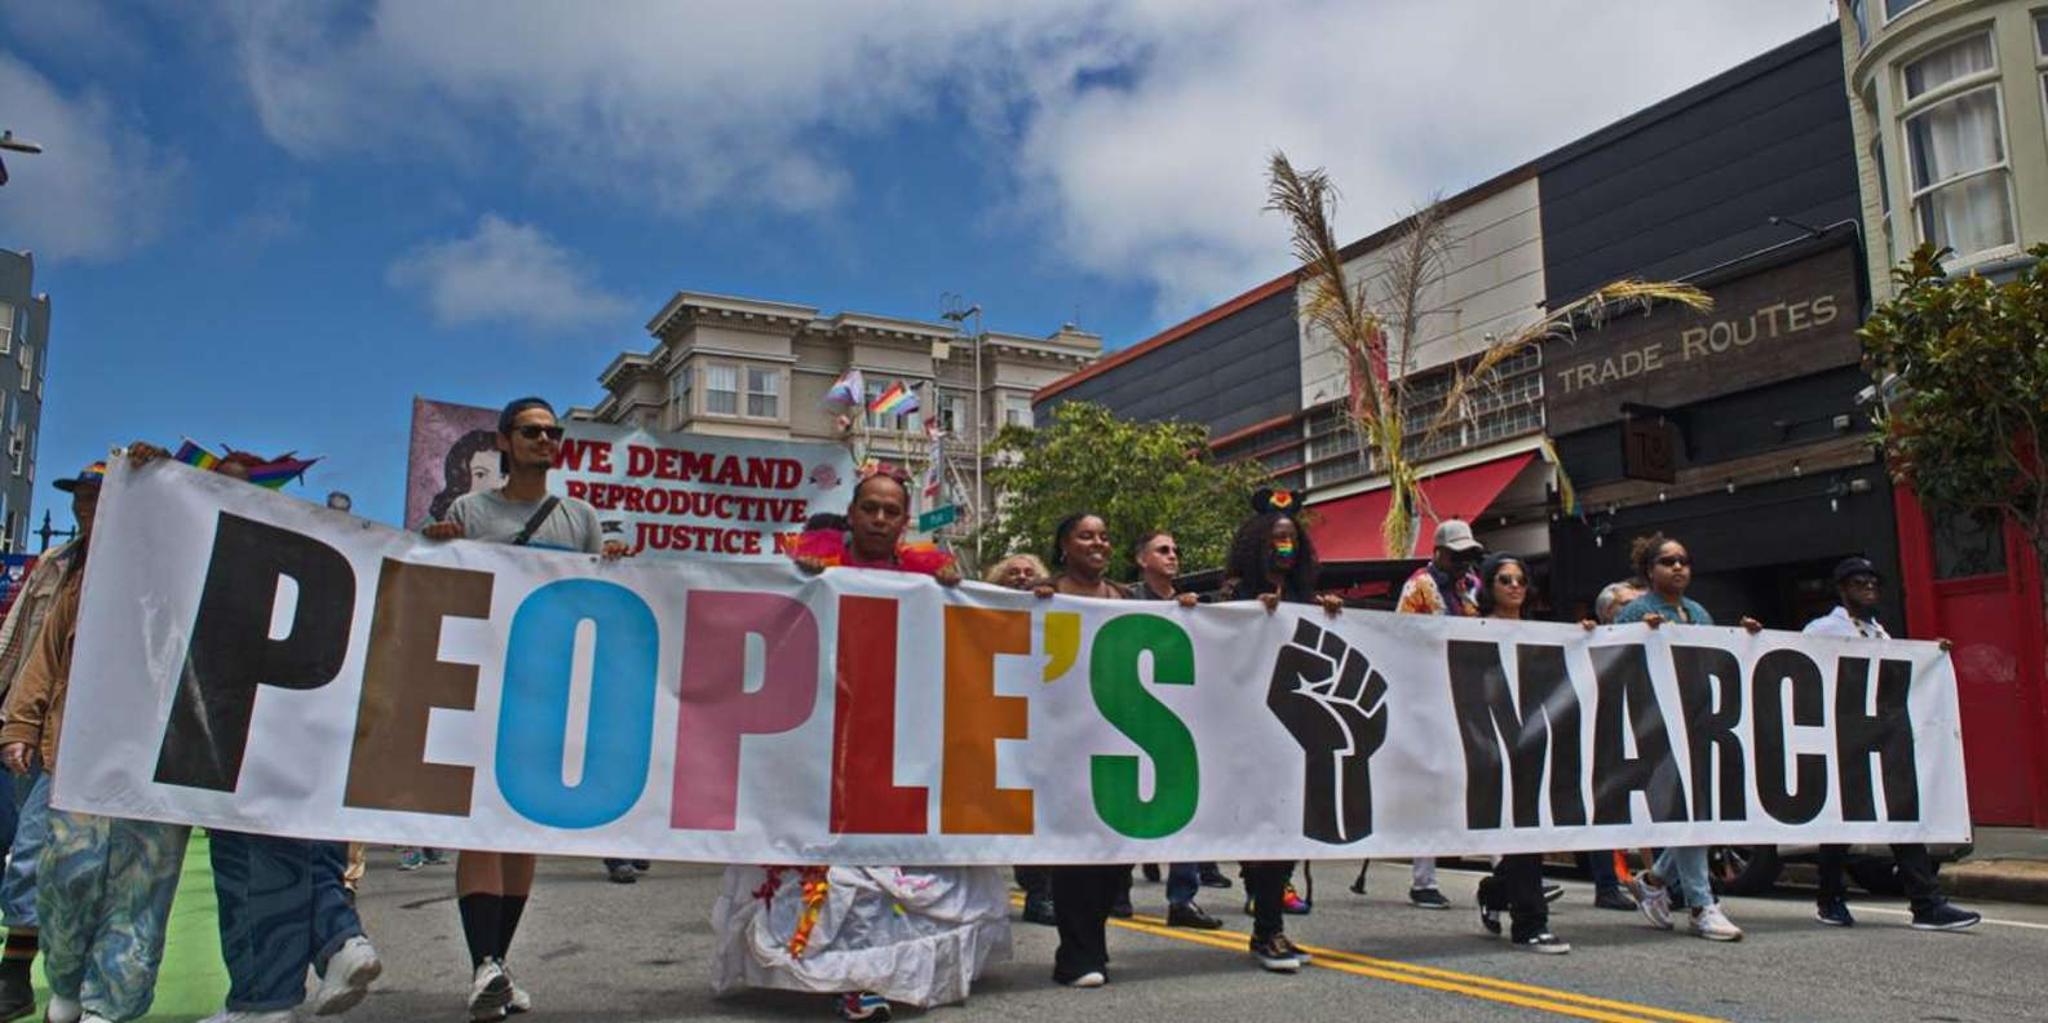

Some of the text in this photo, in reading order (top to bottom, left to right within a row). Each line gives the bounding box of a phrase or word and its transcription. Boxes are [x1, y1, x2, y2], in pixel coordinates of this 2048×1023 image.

[1557, 295, 1837, 393] TRADE ROUTES
[553, 439, 803, 490] WE DEMAND
[565, 480, 808, 523] REPRODUCTIVE
[631, 522, 761, 555] JUSTICE
[154, 511, 1919, 839] PEOPLE'S MARCH
